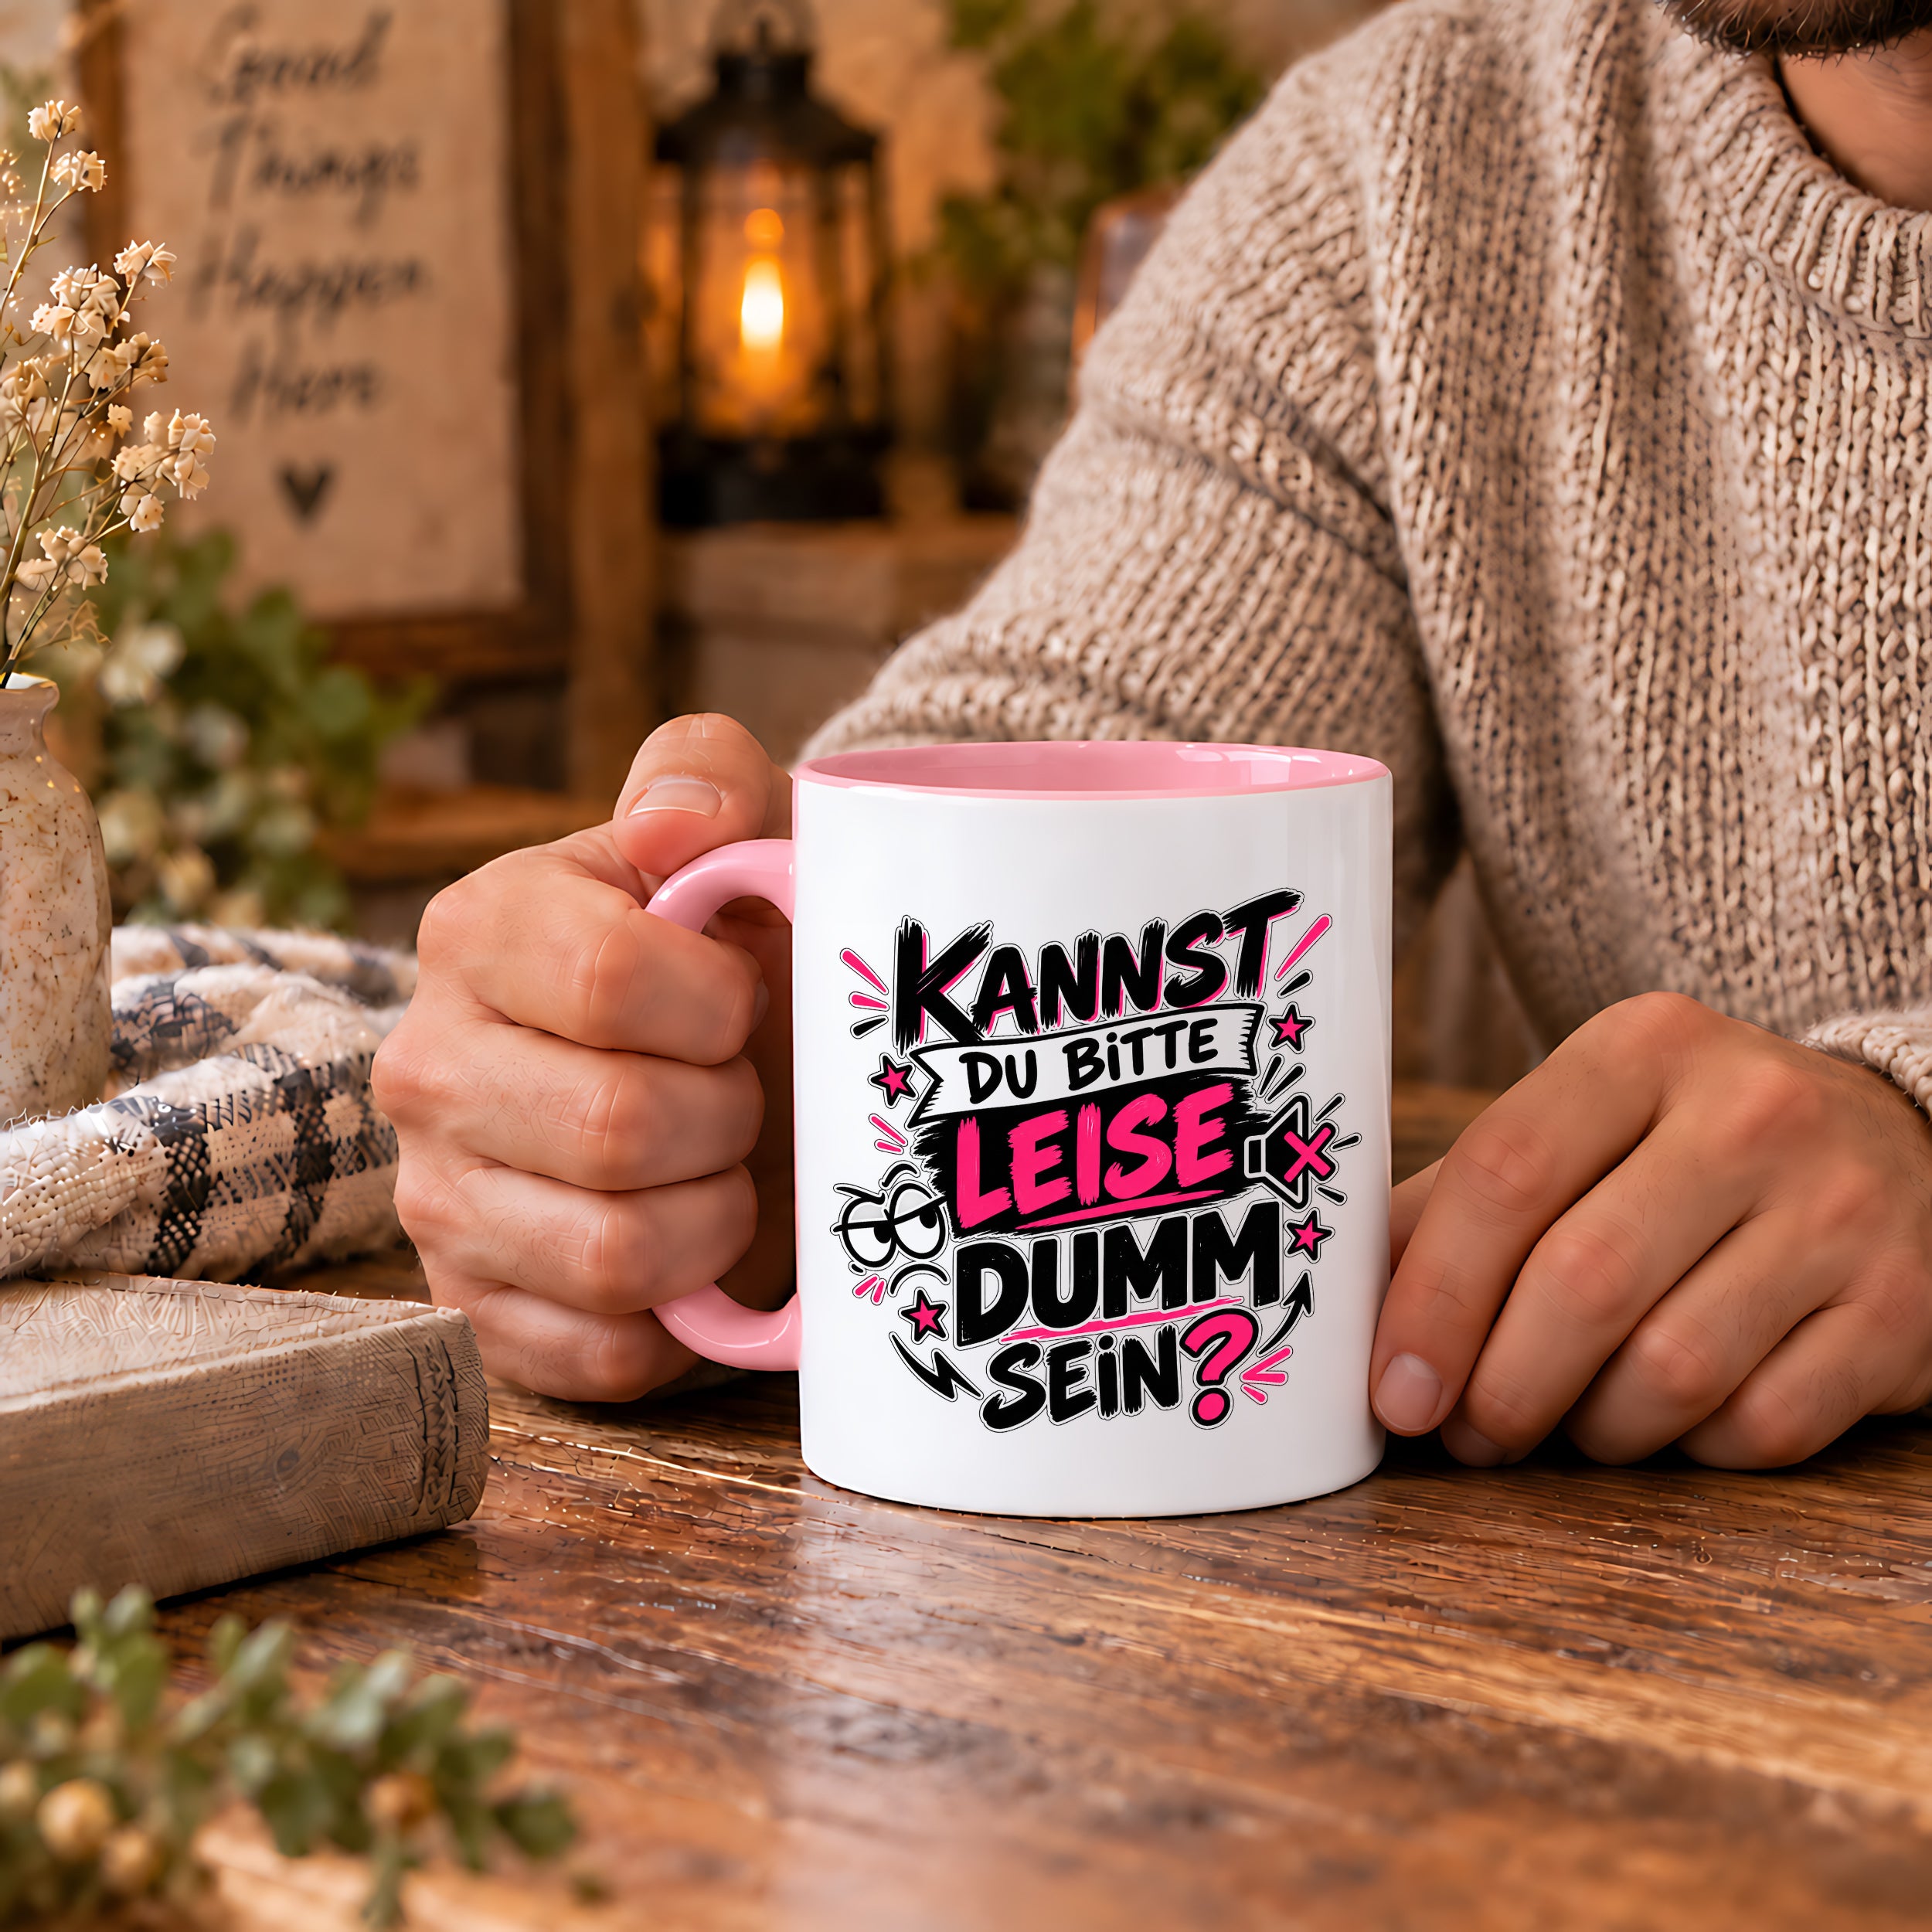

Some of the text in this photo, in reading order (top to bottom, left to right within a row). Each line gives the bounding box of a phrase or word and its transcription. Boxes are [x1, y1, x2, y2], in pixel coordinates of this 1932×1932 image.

[894, 889, 1303, 1052] KANNST
[959, 1049, 1039, 1105] DU
[956, 1083, 1234, 1230] LEISE
[954, 1202, 1281, 1348] DUMM
